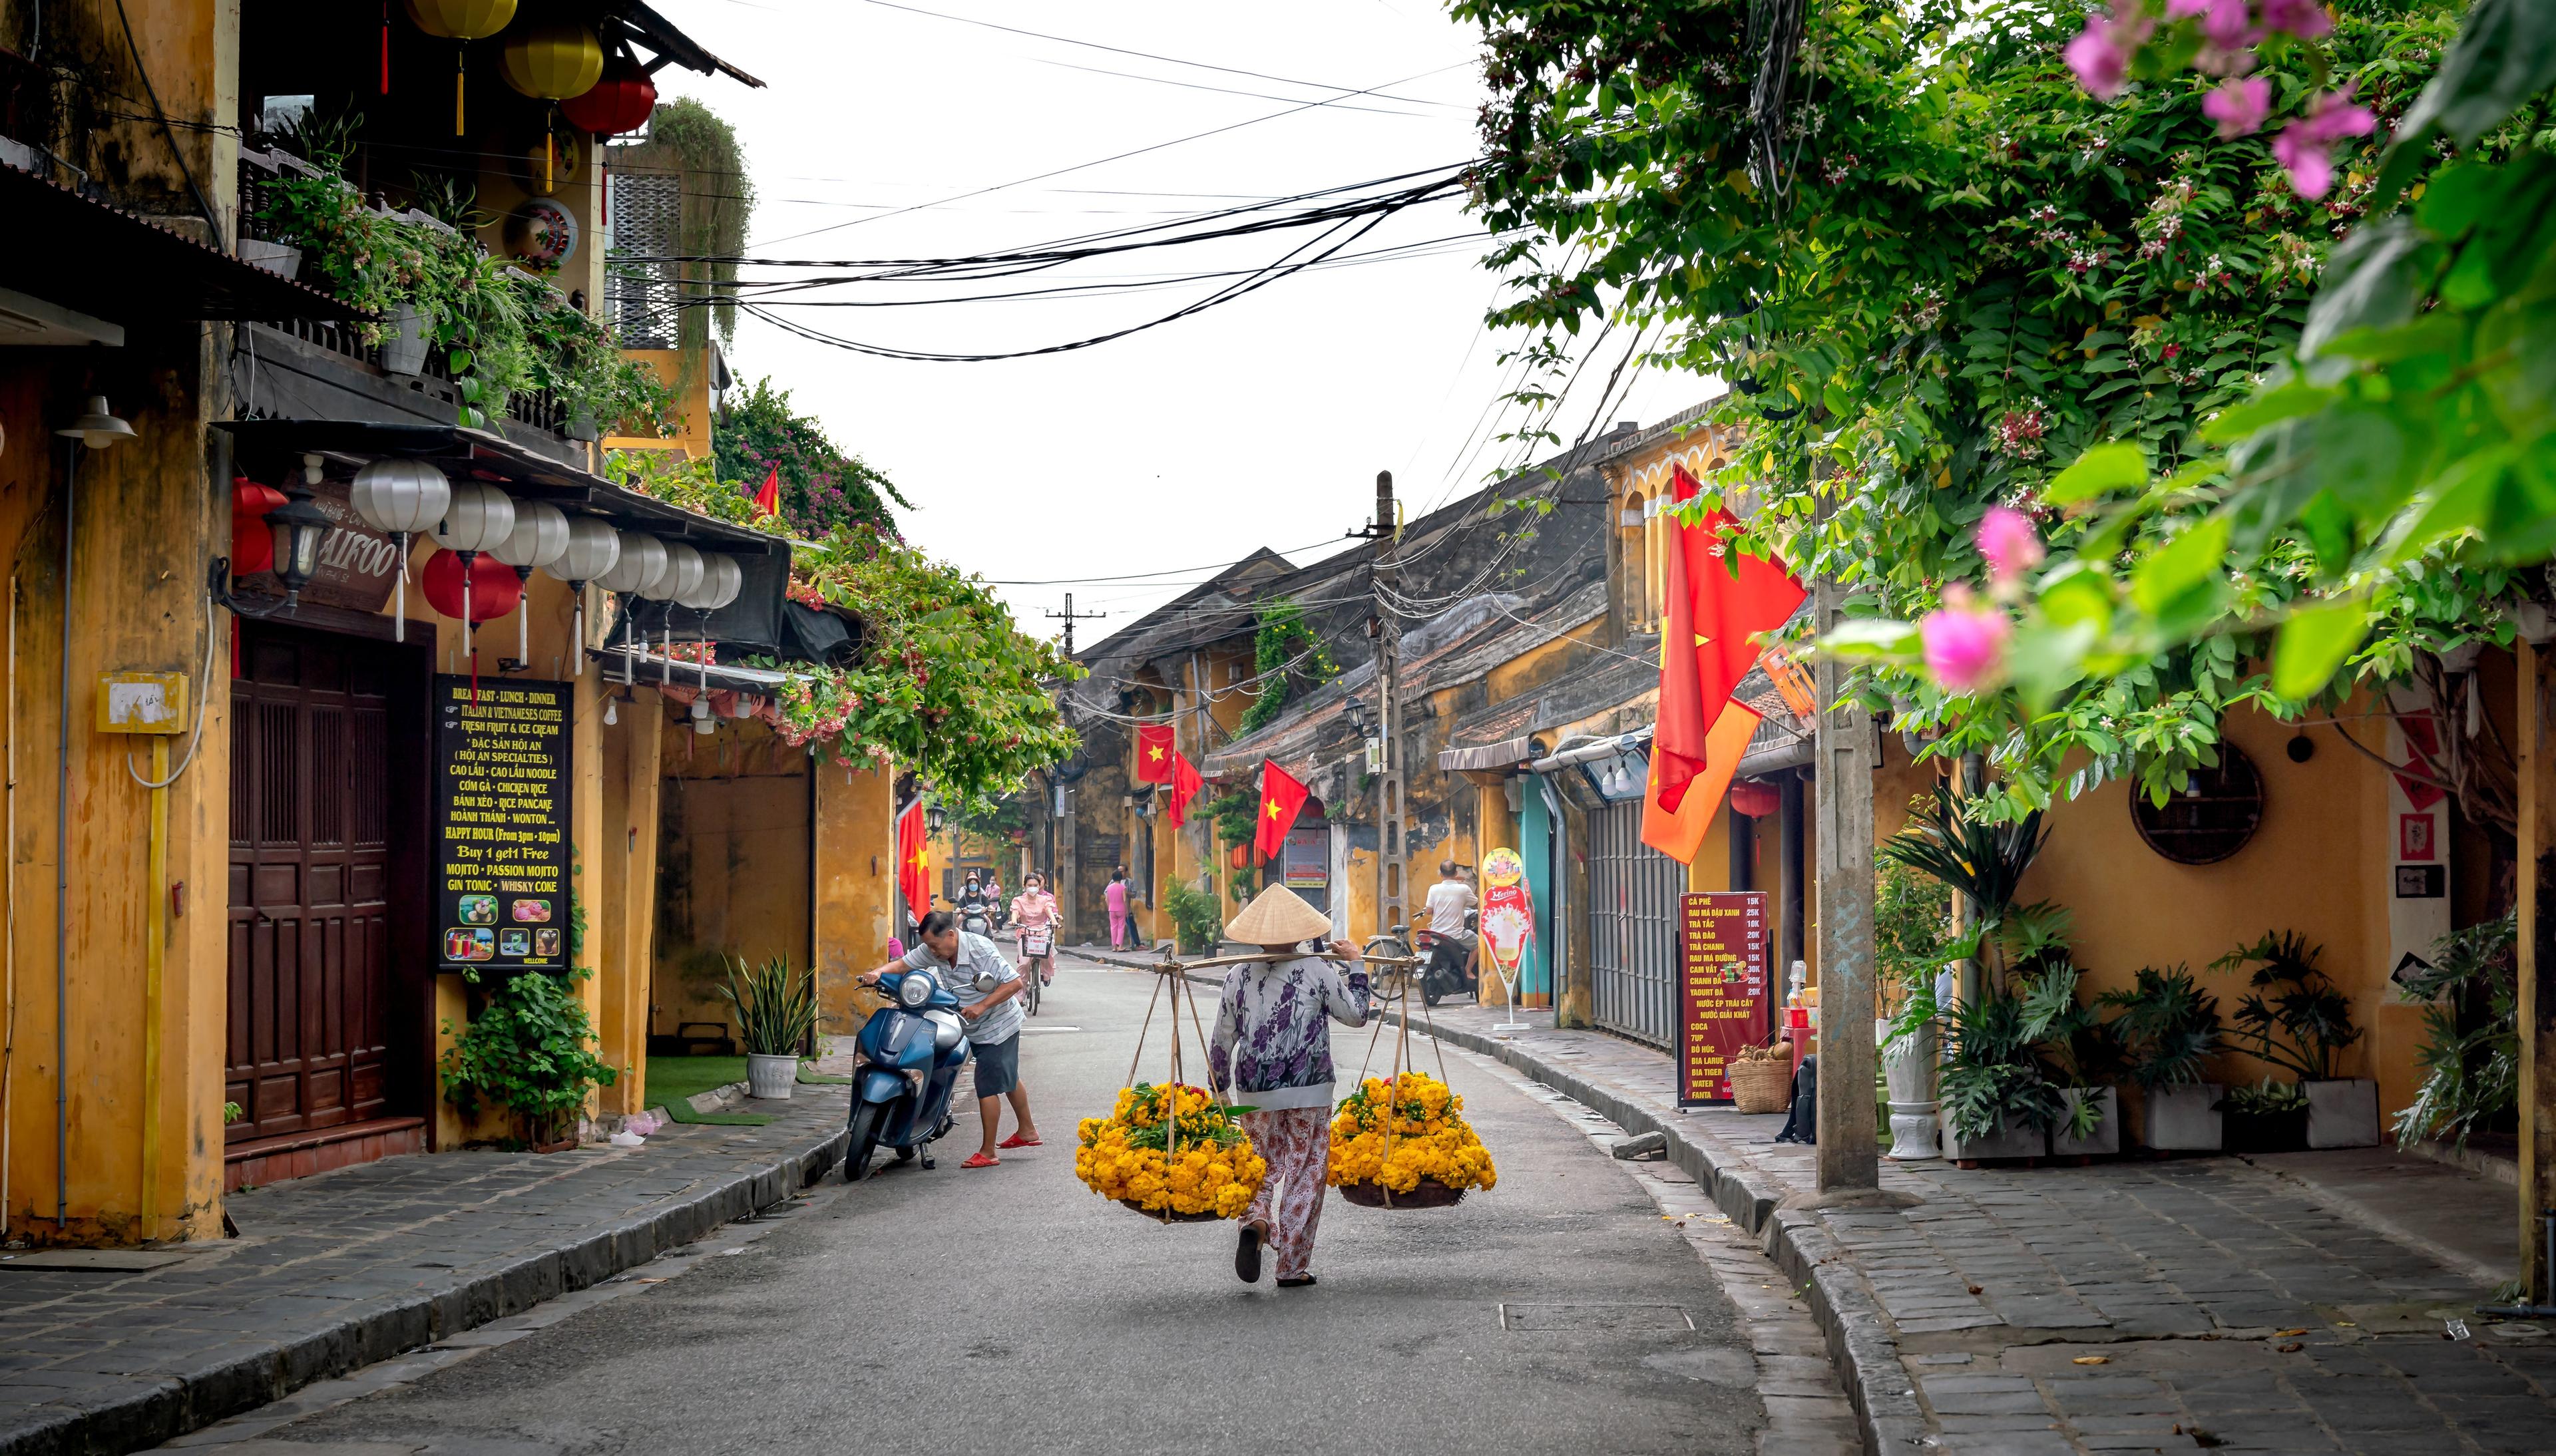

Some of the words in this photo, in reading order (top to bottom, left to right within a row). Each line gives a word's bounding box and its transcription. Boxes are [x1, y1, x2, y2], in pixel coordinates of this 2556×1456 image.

[319, 527, 397, 578] AIFOO
[453, 688, 495, 700] BREAFAST
[501, 691, 524, 703] LUNCH
[529, 693, 556, 705] DINNER
[461, 705, 487, 717] ITALIAN
[488, 707, 493, 718] &
[494, 707, 537, 721] VIETNAMESES
[539, 709, 562, 721] COFFEE
[461, 721, 485, 734] FRESH
[487, 722, 509, 735] FRUIT
[511, 724, 517, 733] &
[519, 723, 530, 733] ICE
[532, 725, 558, 737] CREAM
[492, 737, 510, 749] SẢN
[512, 740, 527, 752] HỘI
[529, 741, 541, 751] AN
[477, 752, 489, 761] AN
[450, 765, 467, 775] CAO
[491, 767, 507, 777] CAO
[527, 768, 556, 779] NOODLE
[479, 779, 491, 791] GÀ
[497, 783, 529, 796] CHICKEN
[531, 784, 548, 797] RICE
[453, 794, 475, 807] BÁNH
[477, 794, 493, 807] XÈO
[499, 798, 516, 811] RICE
[518, 799, 552, 812] PANCAKE
[451, 808, 478, 822] HOÀNH
[480, 810, 506, 822] THÁNH
[445, 827, 471, 840] HAPPY
[472, 828, 494, 840] HOUR
[496, 827, 517, 842] (From
[518, 830, 533, 842] 3pm
[538, 828, 560, 844] 10pm)
[457, 845, 483, 861] Buy
[486, 847, 492, 858] 1
[522, 847, 549, 859] Free
[447, 864, 479, 877] MOJITO
[487, 864, 525, 876] PASSION
[527, 866, 558, 879] MOJITO
[447, 880, 463, 891] GIN
[465, 880, 492, 891] TONIC
[501, 880, 534, 892] WHISKY
[535, 881, 557, 892] COKE
[1492, 890, 1516, 898] Merino
[1699, 896, 1711, 905] PHÊ
[1701, 908, 1711, 916] MÁ
[1703, 953, 1714, 962] MÁ
[1715, 988, 1723, 996] ĐÁ
[1715, 998, 1724, 1007] ÉP
[1741, 999, 1753, 1007] CÂY
[1734, 1010, 1750, 1019] KHÁT
[1702, 1044, 1715, 1053] HÚC
